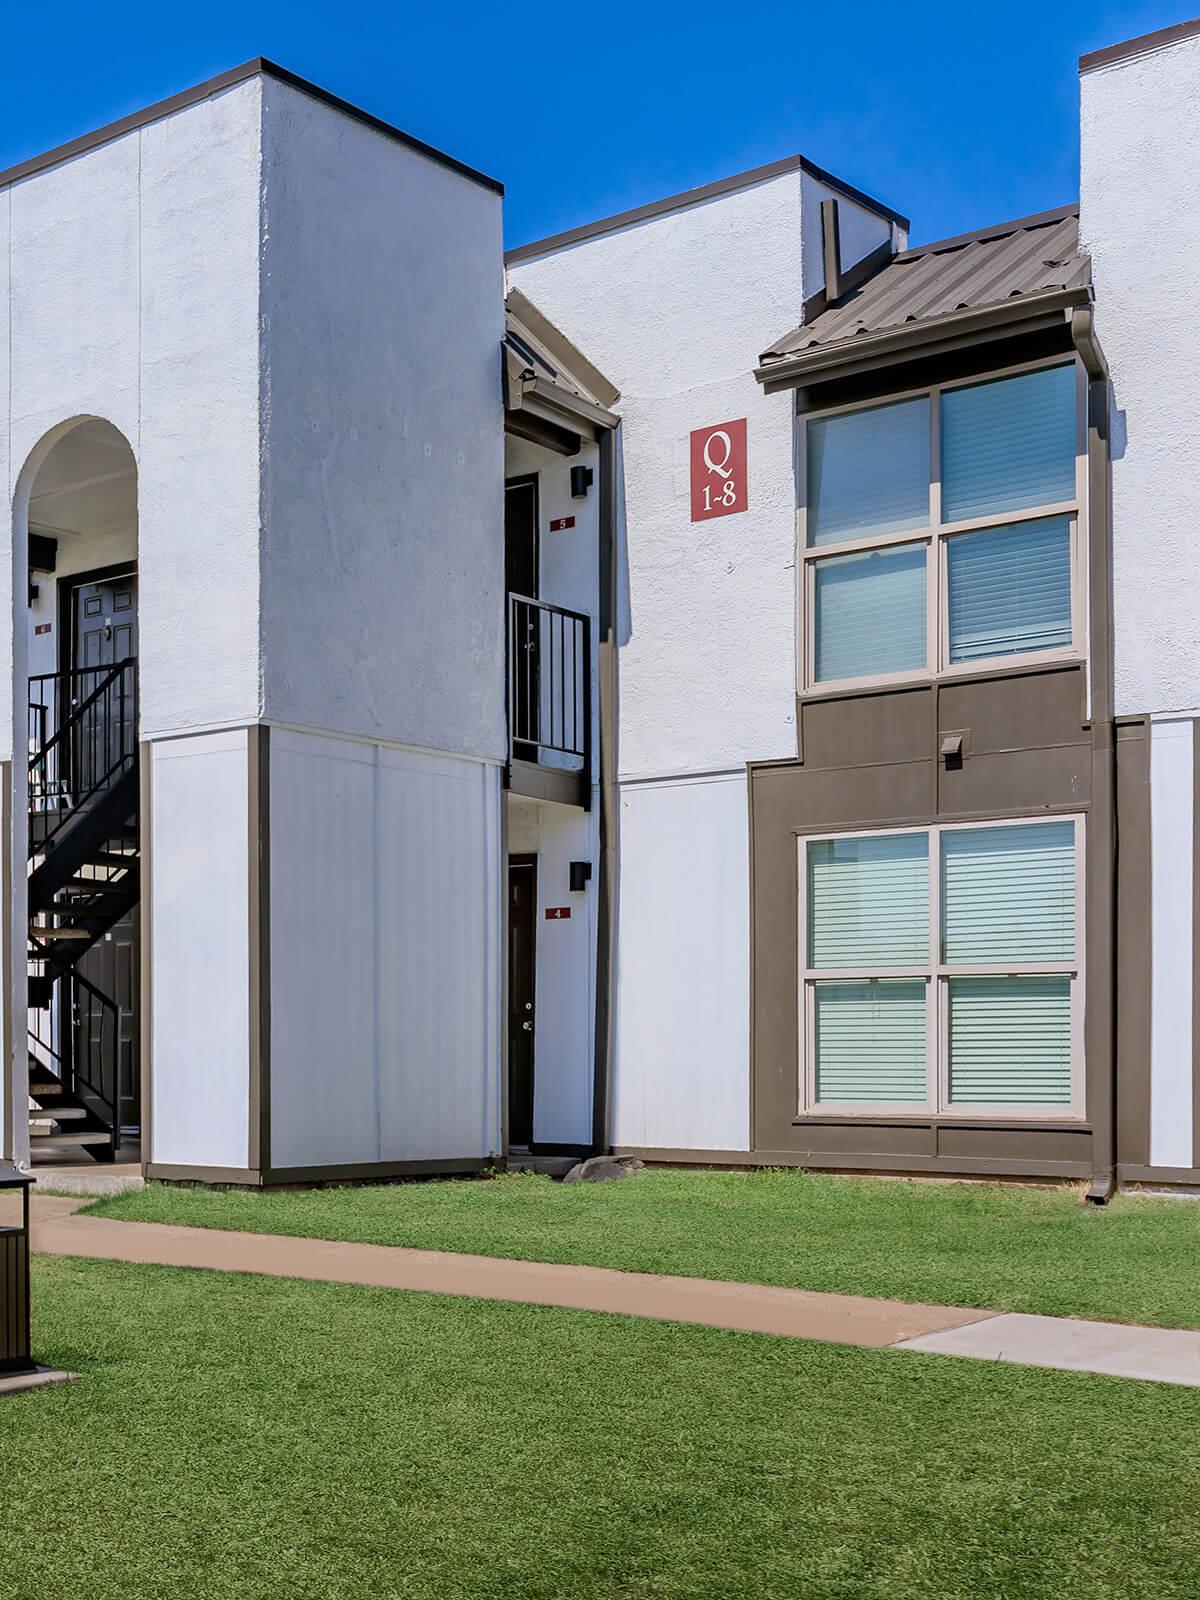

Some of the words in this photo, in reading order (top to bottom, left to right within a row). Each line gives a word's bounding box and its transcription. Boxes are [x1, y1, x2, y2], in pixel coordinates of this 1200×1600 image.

[703, 430, 733, 479] Q
[559, 519, 566, 529] 5
[554, 909, 561, 918] 4
